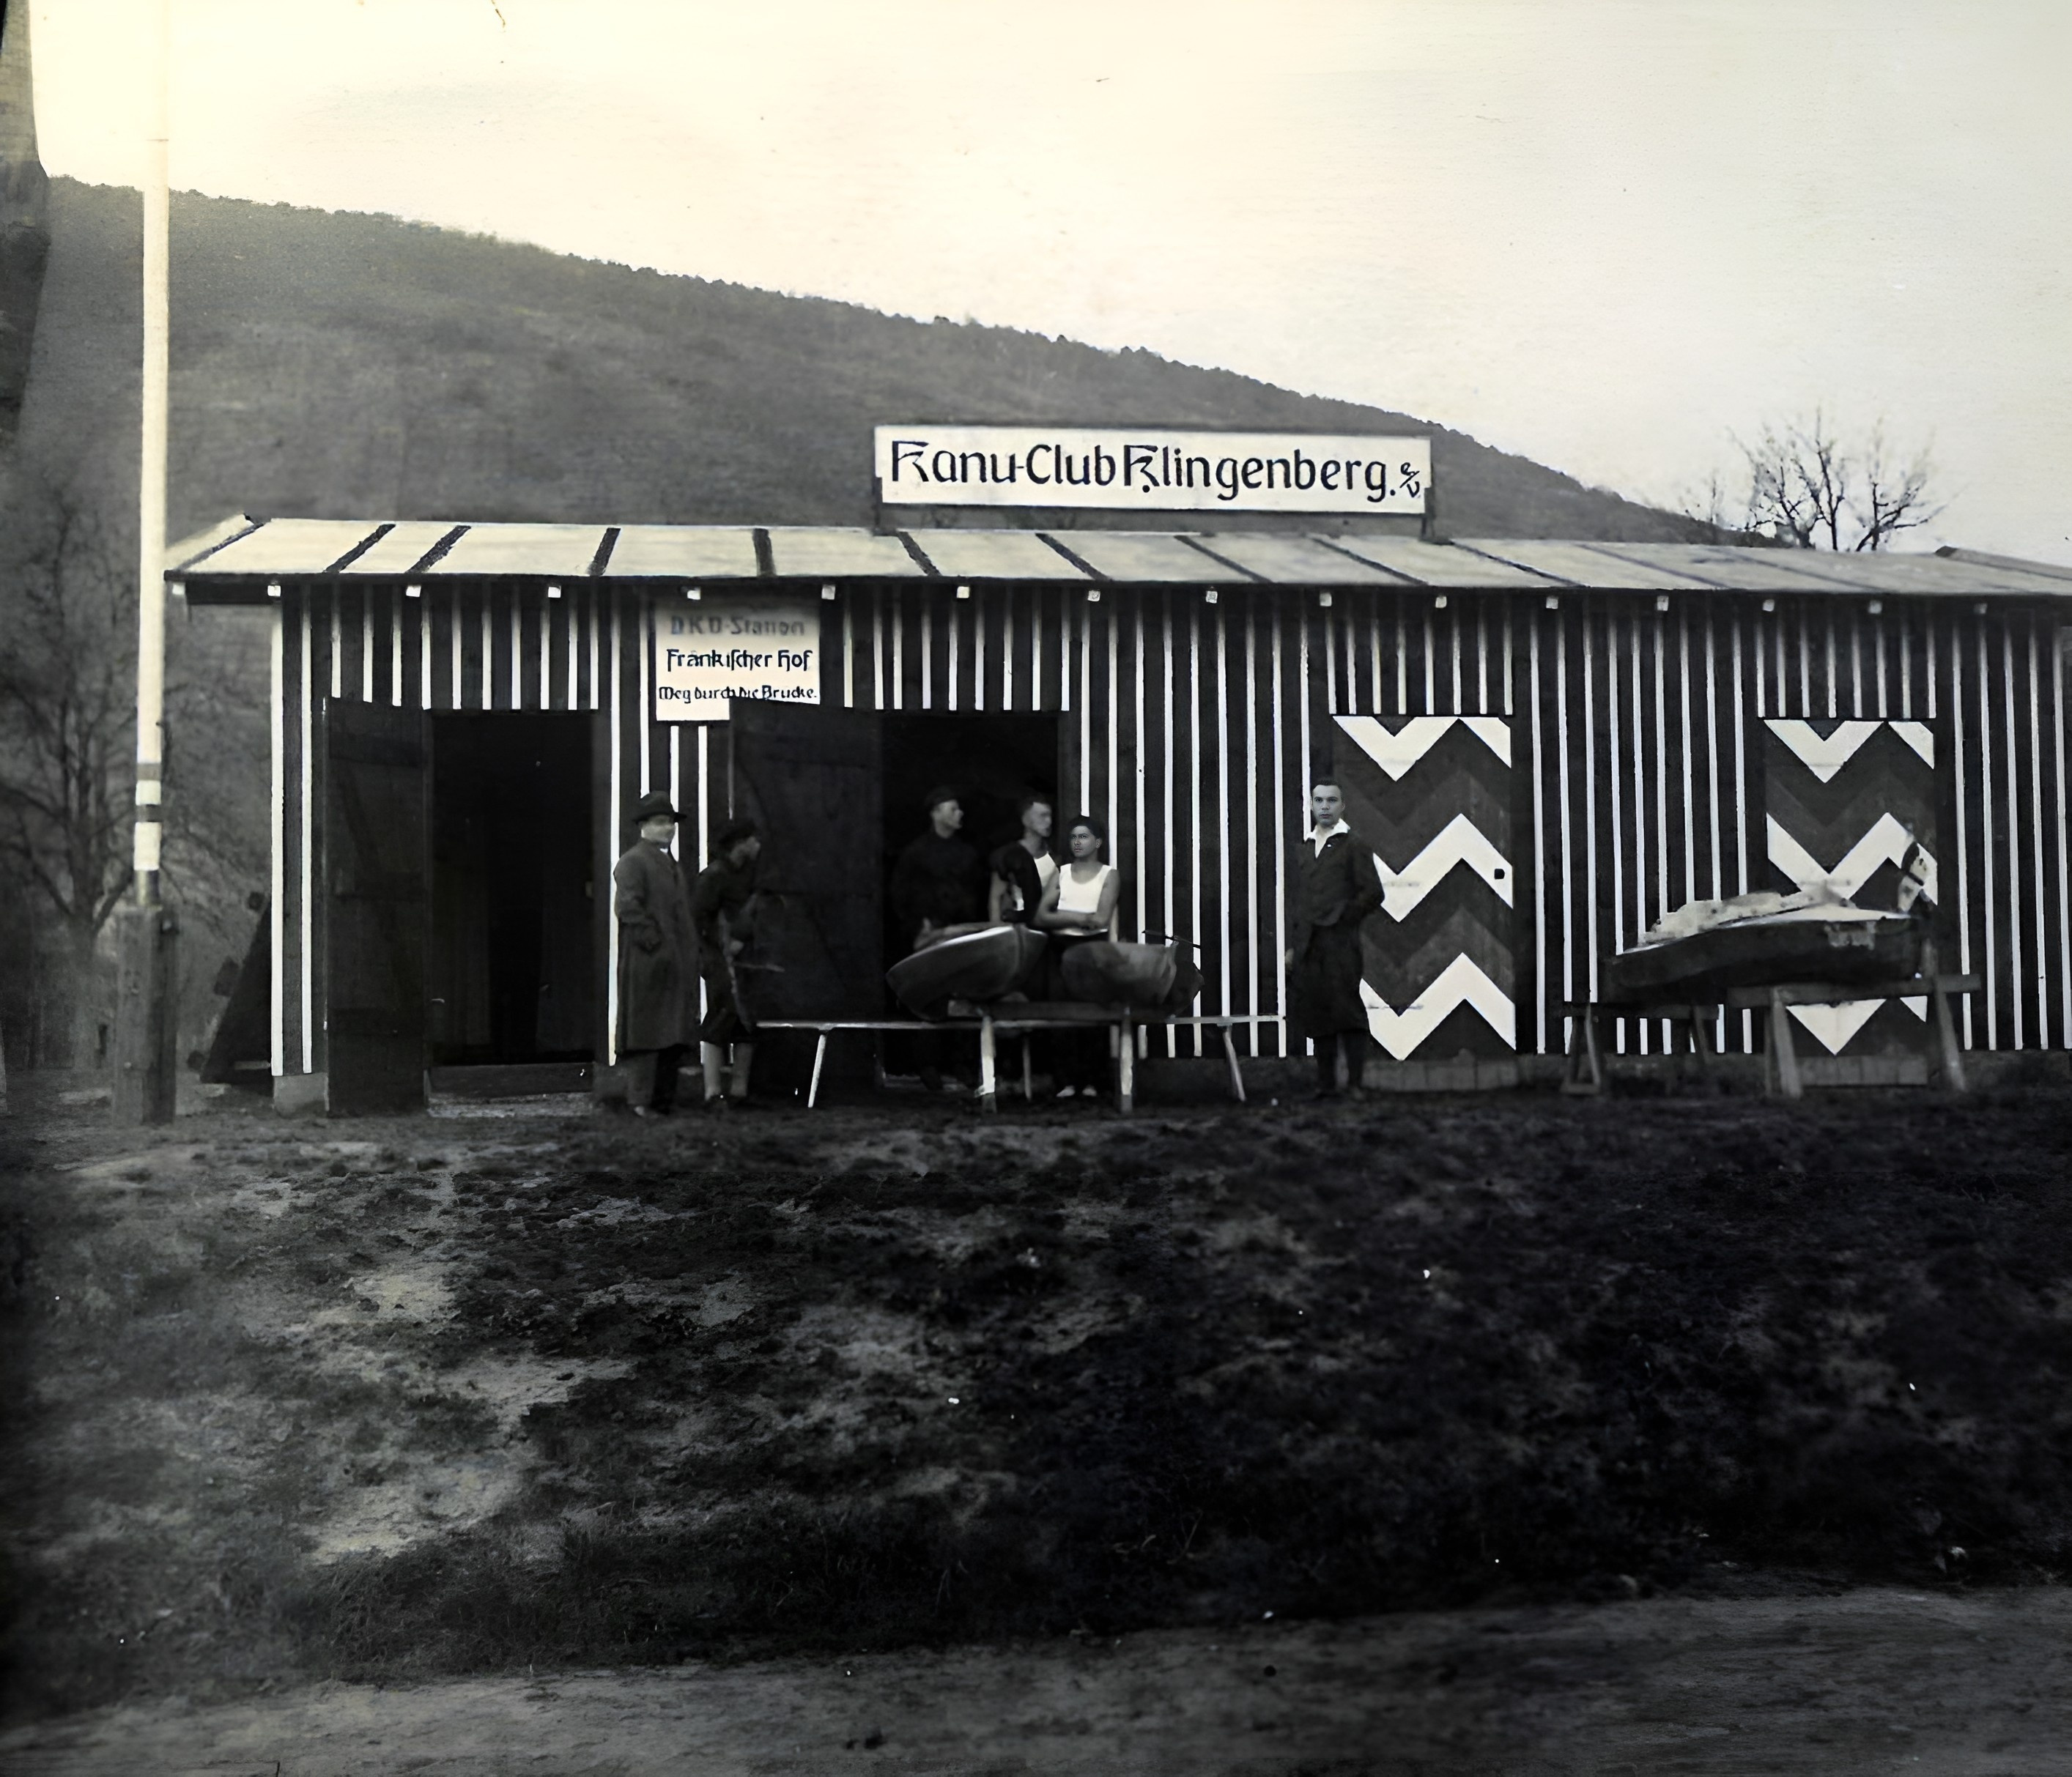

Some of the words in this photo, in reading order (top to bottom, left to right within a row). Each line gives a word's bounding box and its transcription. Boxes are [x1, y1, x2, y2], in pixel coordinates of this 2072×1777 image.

[892, 440, 1116, 485] Kanu-Club
[1123, 444, 1396, 503] Klingenberg.
[778, 649, 813, 672] Hof
